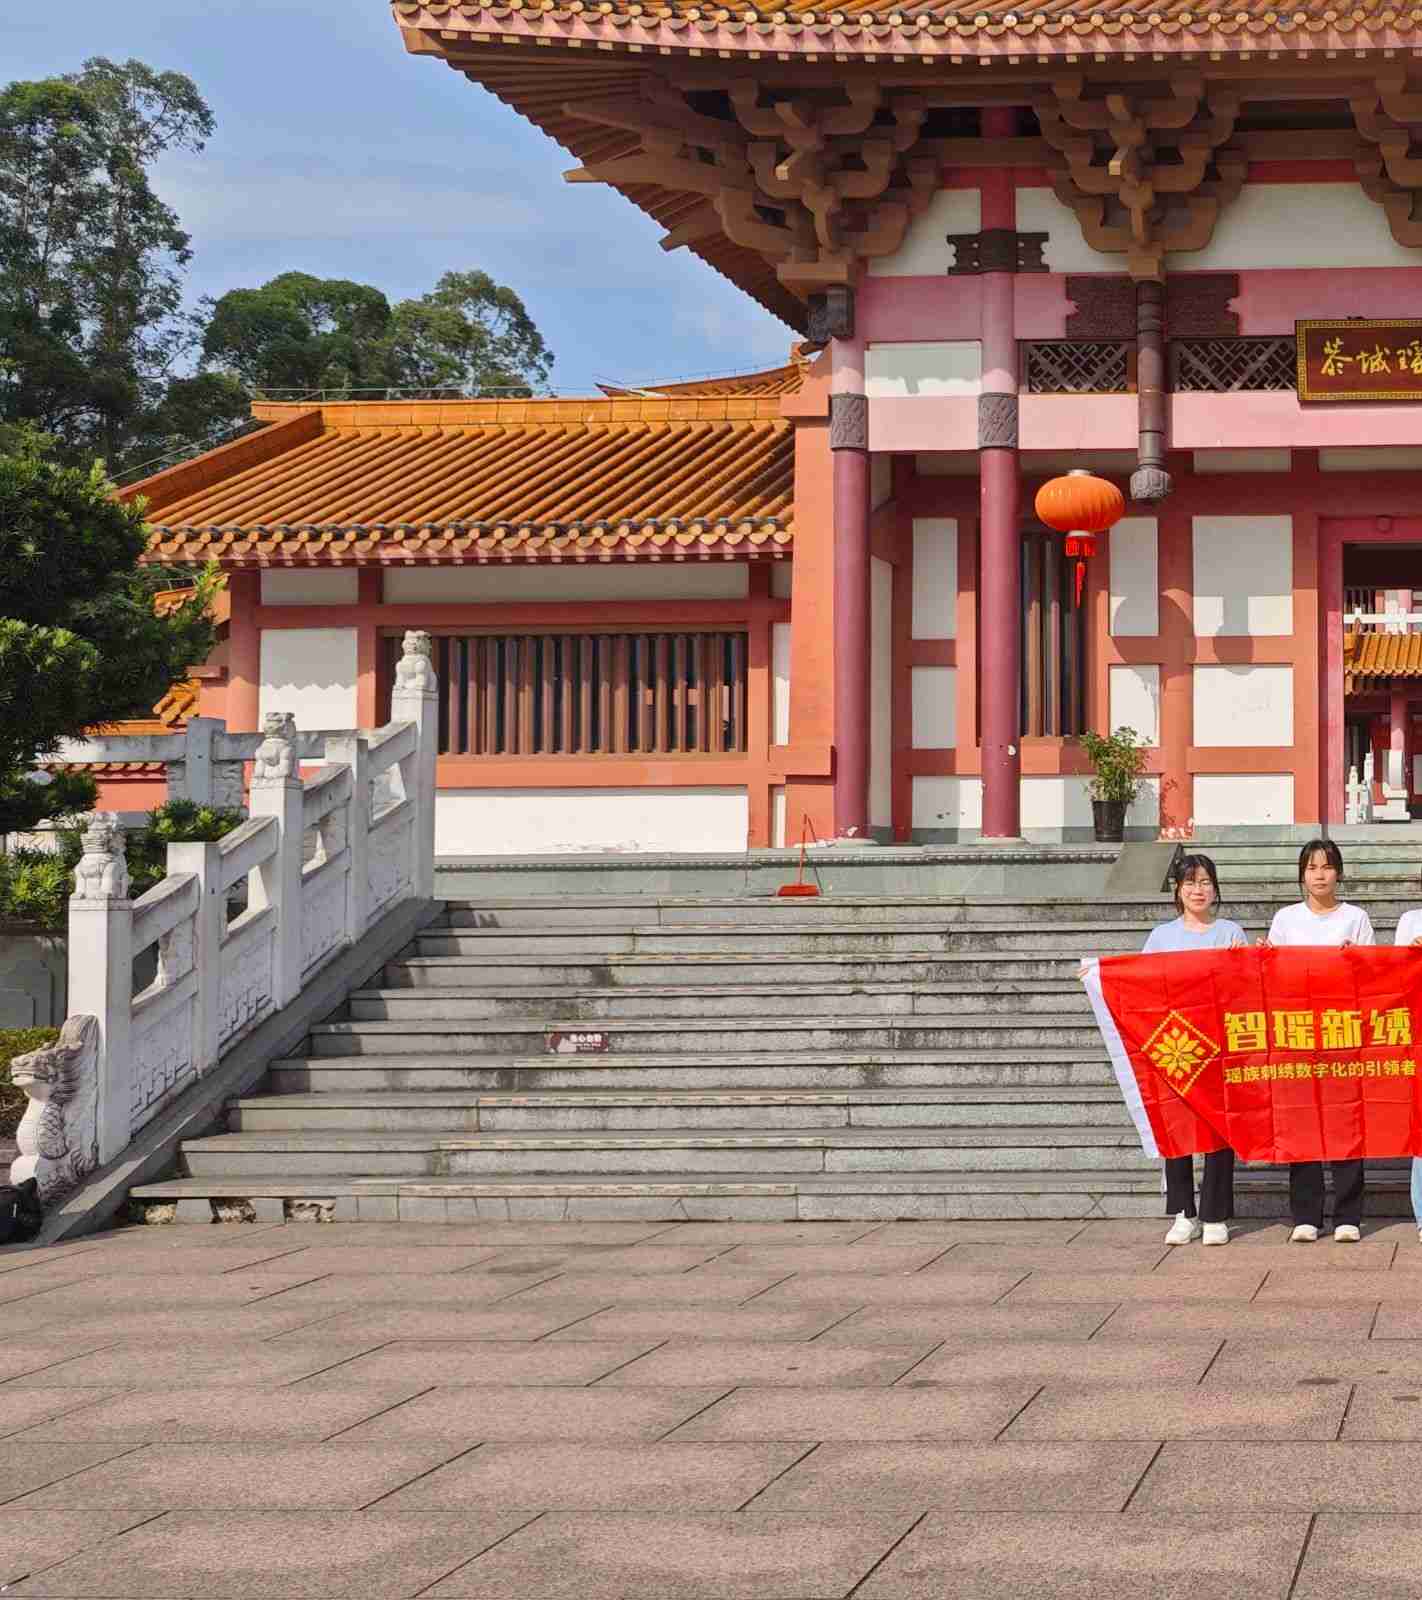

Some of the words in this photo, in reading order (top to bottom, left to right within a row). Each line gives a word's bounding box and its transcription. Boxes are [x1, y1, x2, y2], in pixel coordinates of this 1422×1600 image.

[1223, 1007, 1412, 1052] 智瑶新绣
[1225, 1059, 1417, 1084] 瑶族刺绣数字化的引领者
